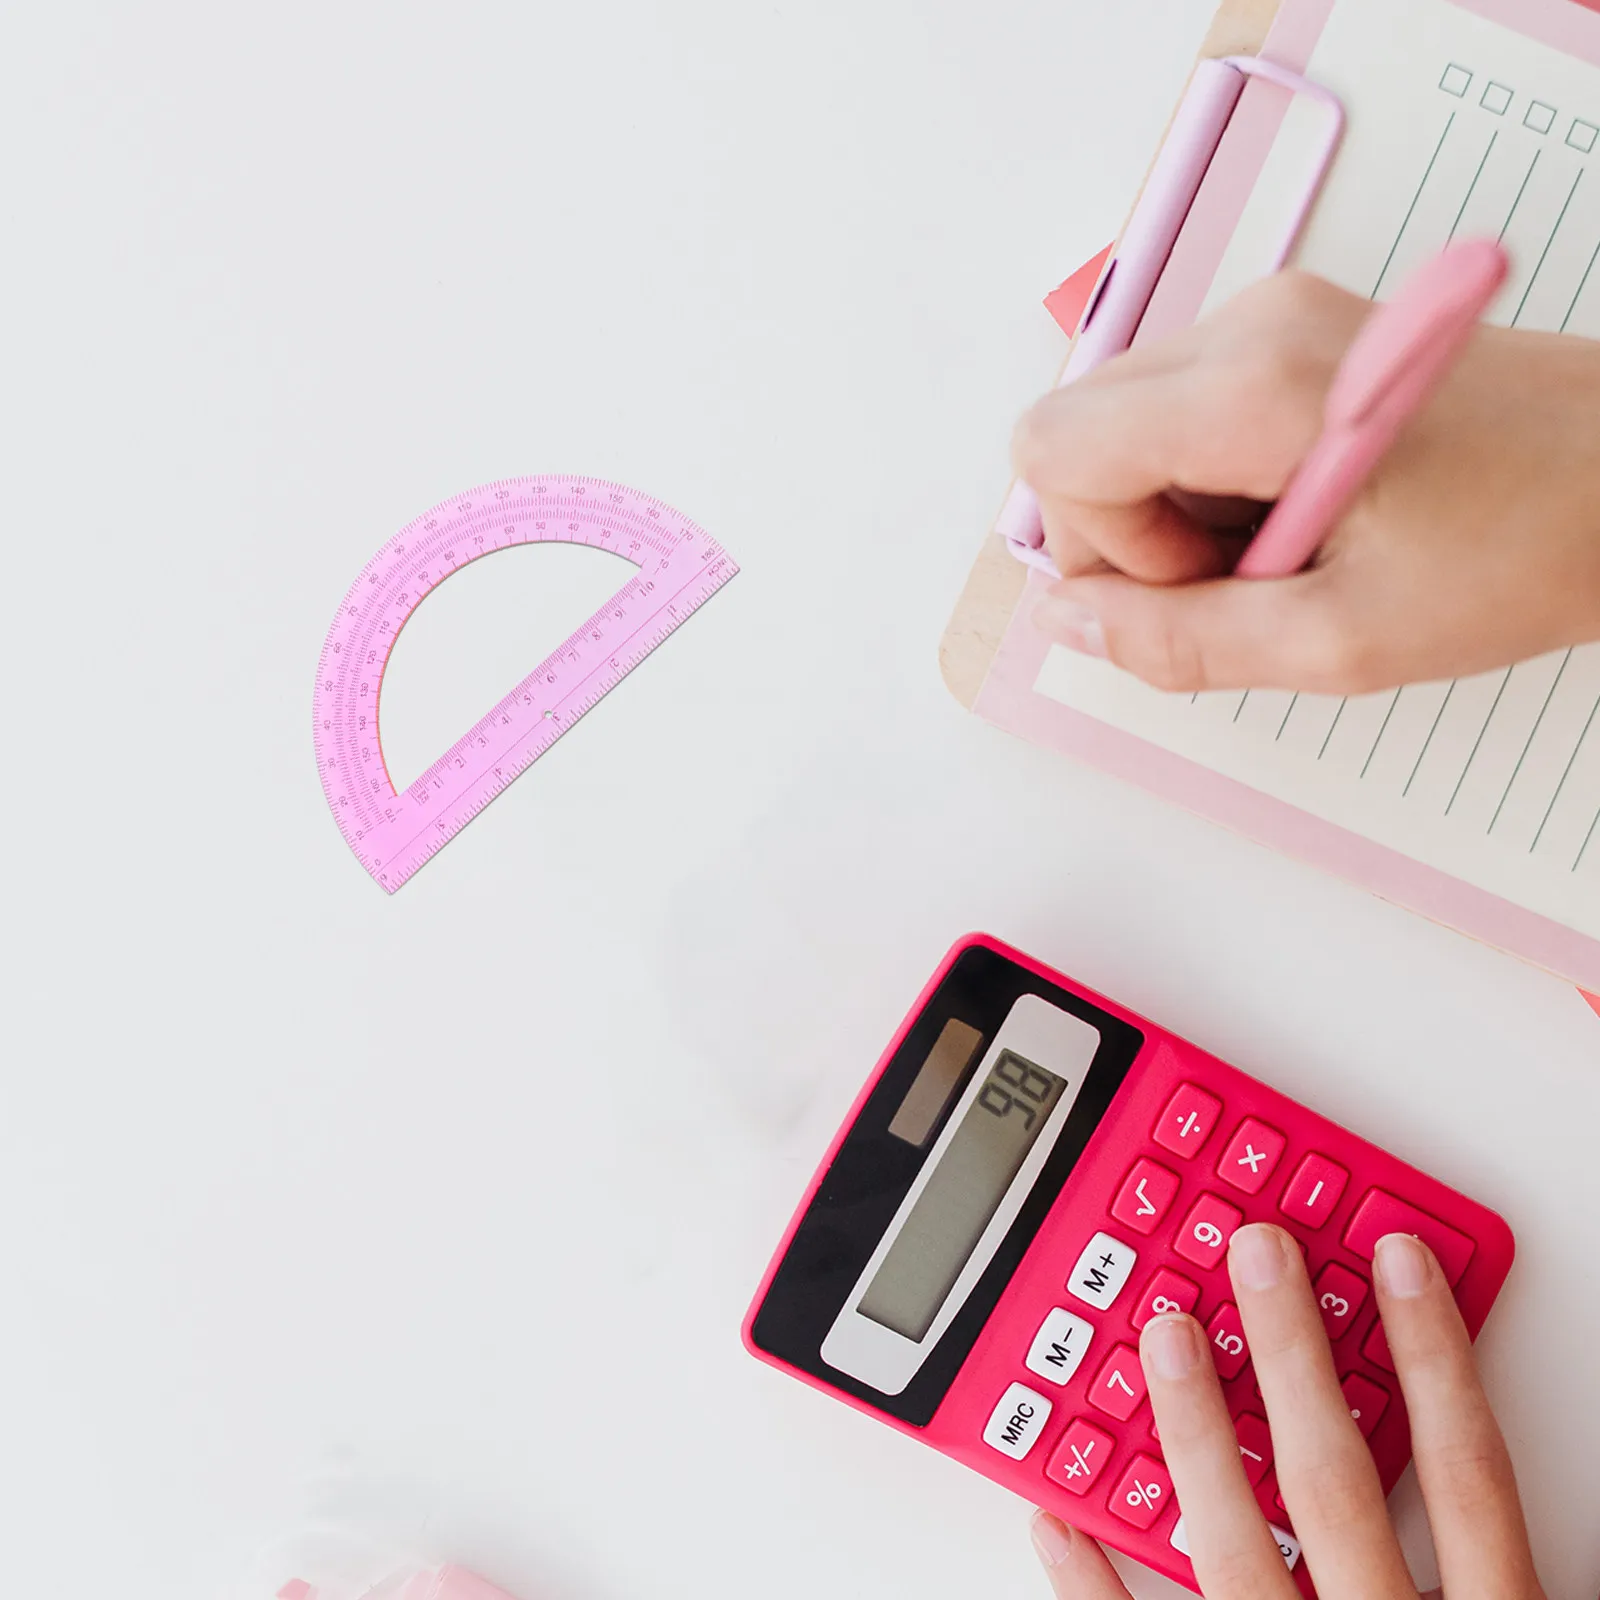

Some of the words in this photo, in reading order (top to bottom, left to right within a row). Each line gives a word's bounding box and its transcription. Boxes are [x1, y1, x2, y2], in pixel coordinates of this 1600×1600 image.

[640, 581, 655, 597] 10
[1193, 1222, 1222, 1247] 9
[1083, 1253, 1115, 1293] M+
[1320, 1292, 1348, 1316] 3
[1214, 1329, 1244, 1355] 5
[1107, 1370, 1134, 1396] 7
[1001, 1402, 1034, 1445] MRC
[1239, 1445, 1262, 1461] 1
[1126, 1479, 1161, 1510] %
